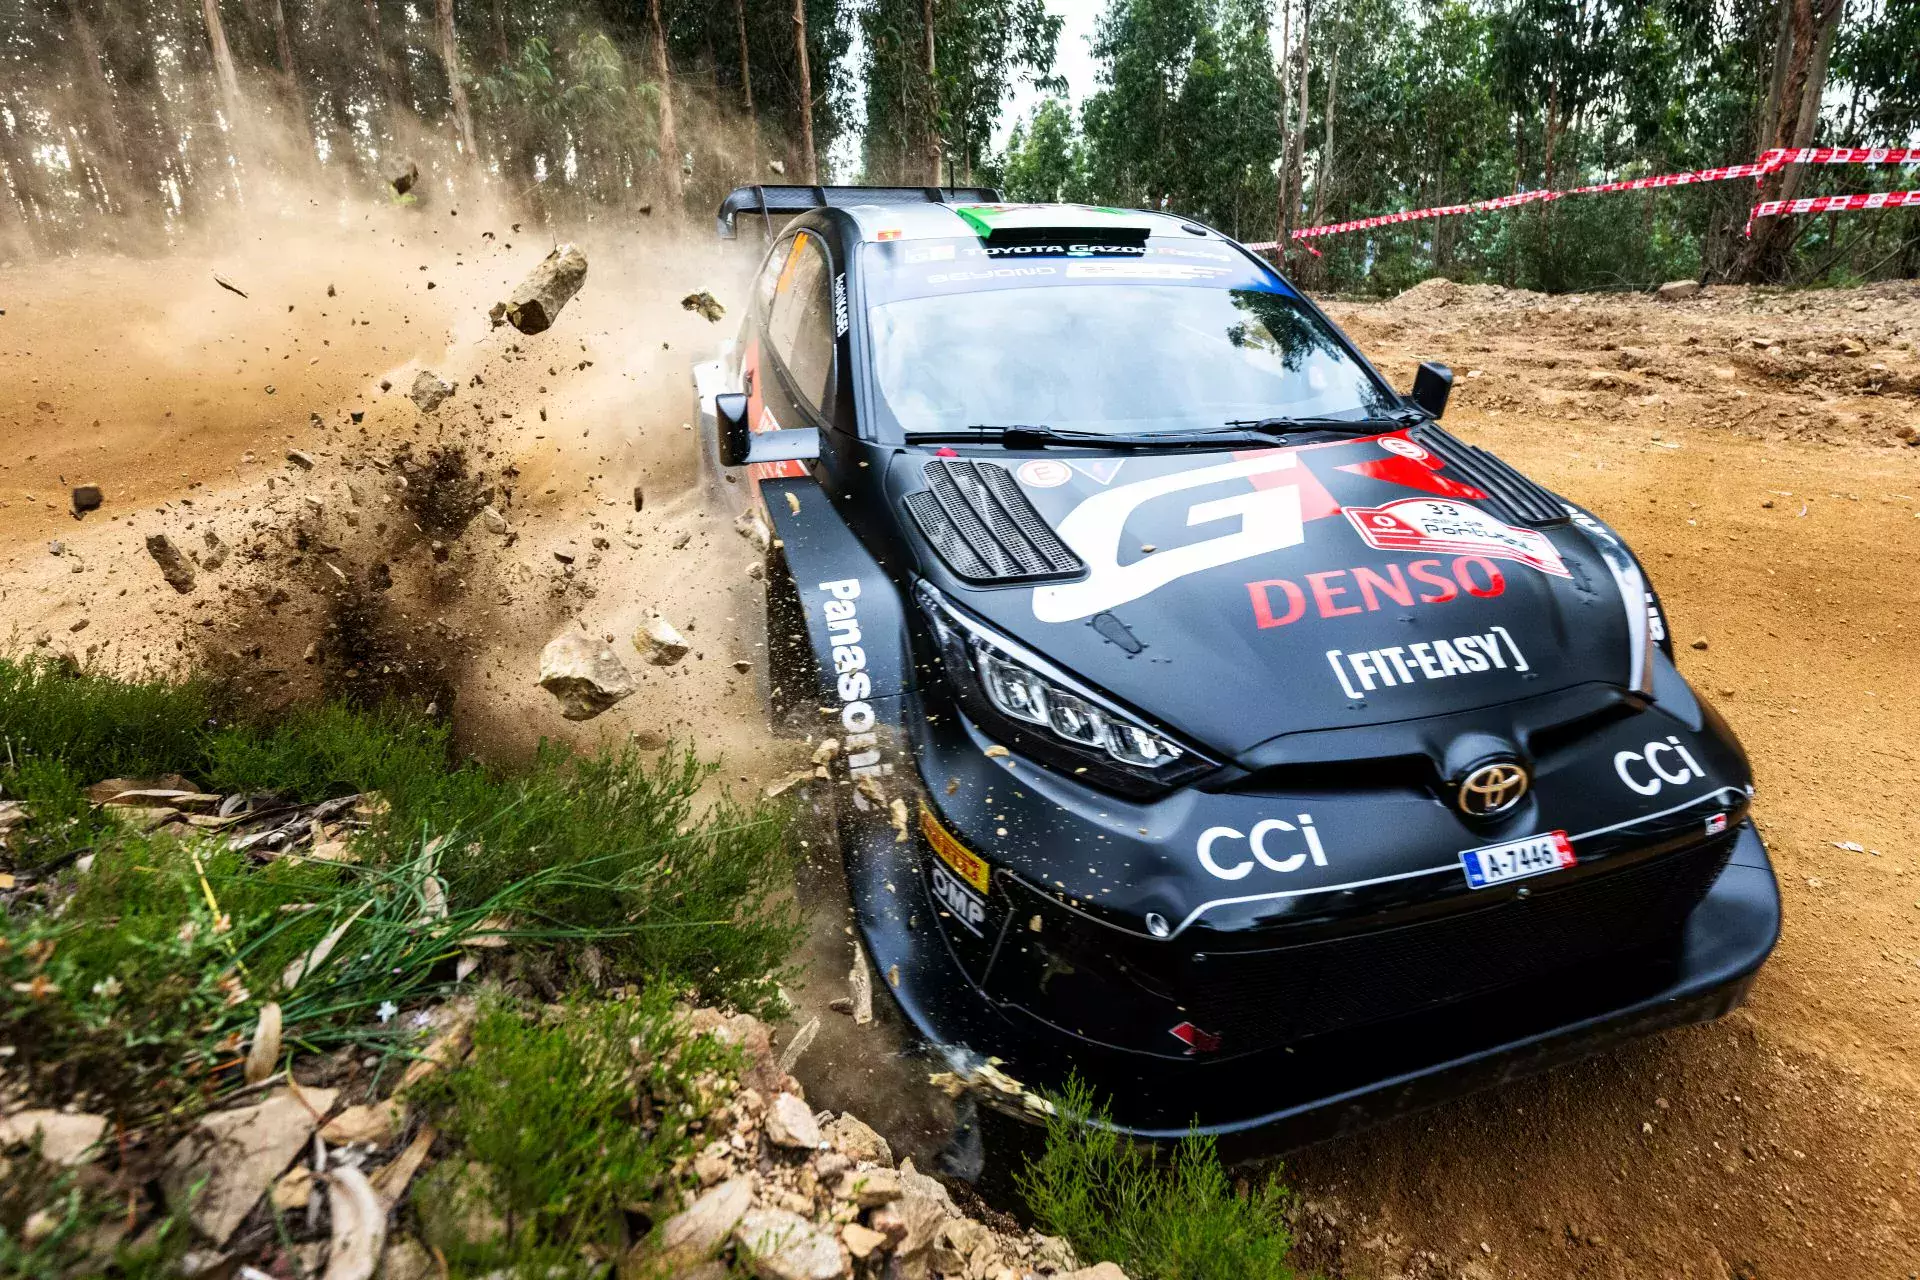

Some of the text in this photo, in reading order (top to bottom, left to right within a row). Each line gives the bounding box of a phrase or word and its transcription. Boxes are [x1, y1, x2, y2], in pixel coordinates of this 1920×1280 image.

[962, 244, 1064, 257] TOYOTA
[927, 266, 1057, 284] BEYOND
[1425, 503, 1460, 516] 33
[1244, 555, 1507, 630] DENSO
[1487, 842, 1555, 879] A-7446
[931, 870, 986, 926] OMP
